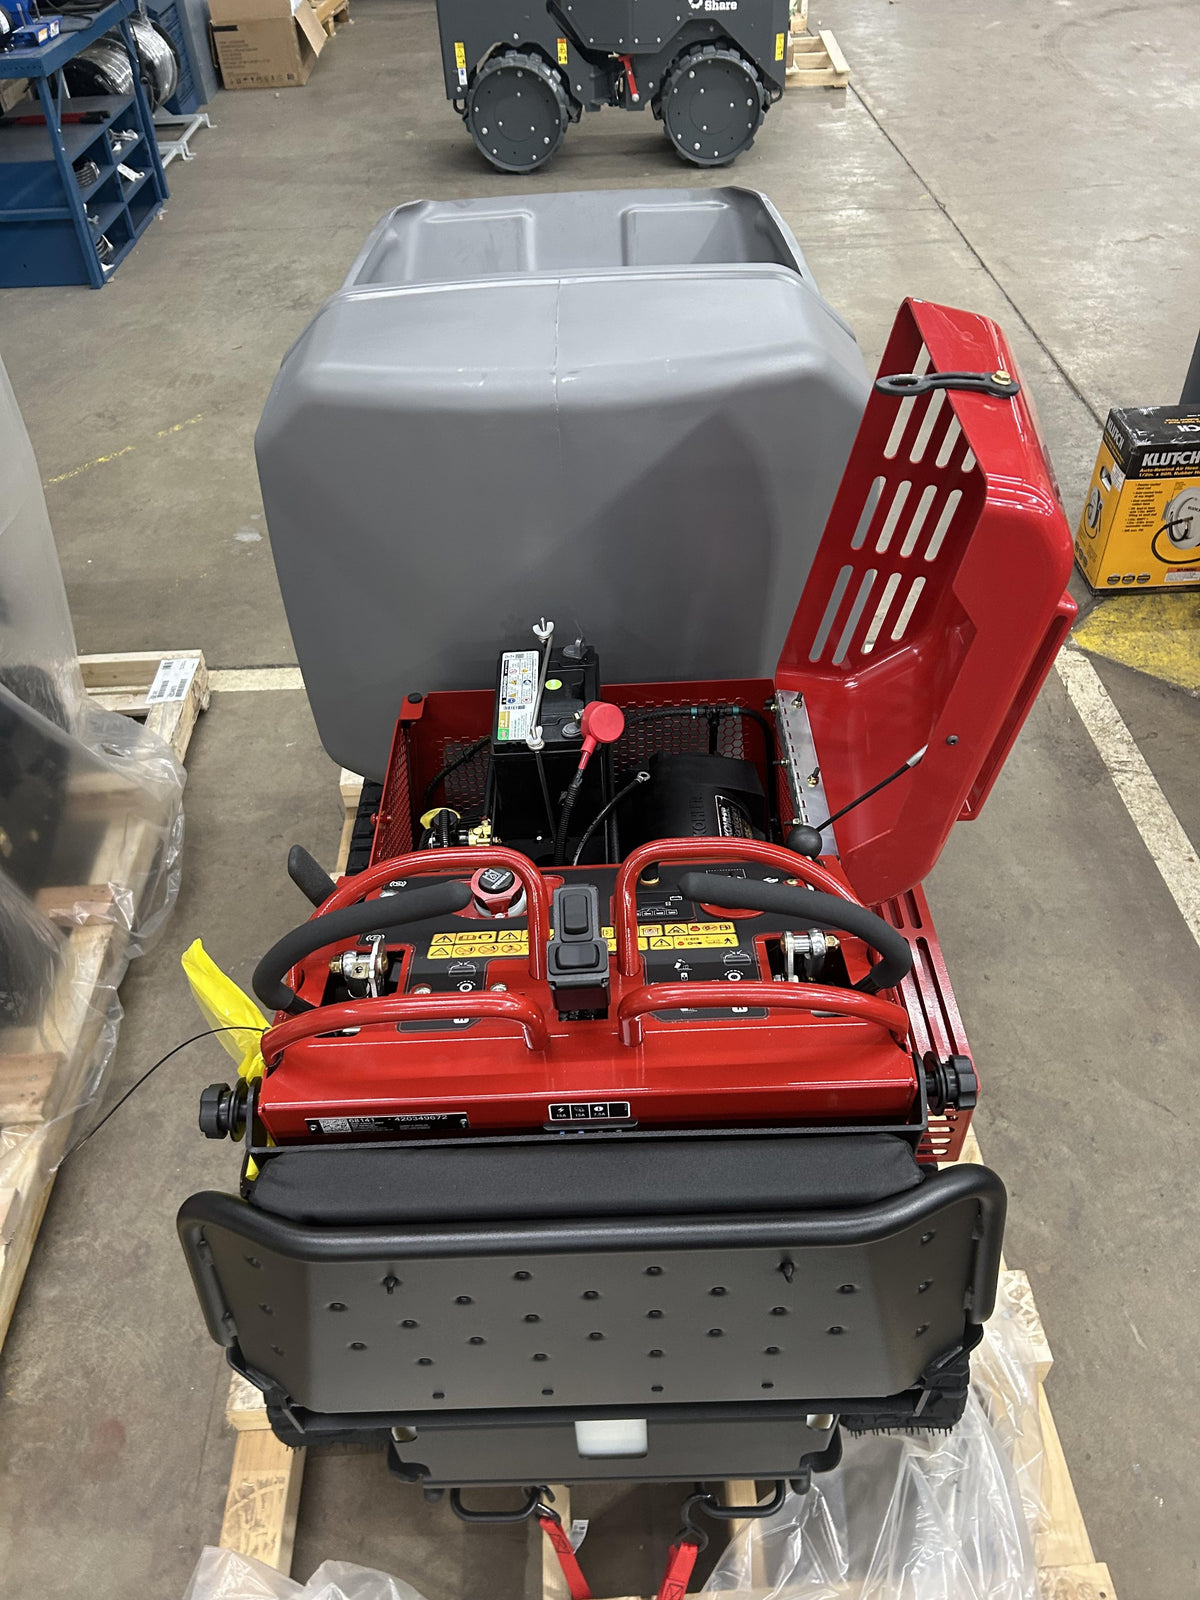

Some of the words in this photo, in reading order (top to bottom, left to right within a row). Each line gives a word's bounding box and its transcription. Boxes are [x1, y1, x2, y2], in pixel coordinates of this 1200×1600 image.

[704, 0, 738, 11] Share
[1106, 418, 1125, 450] KLUTCH
[1141, 450, 1200, 467] KLUTCH
